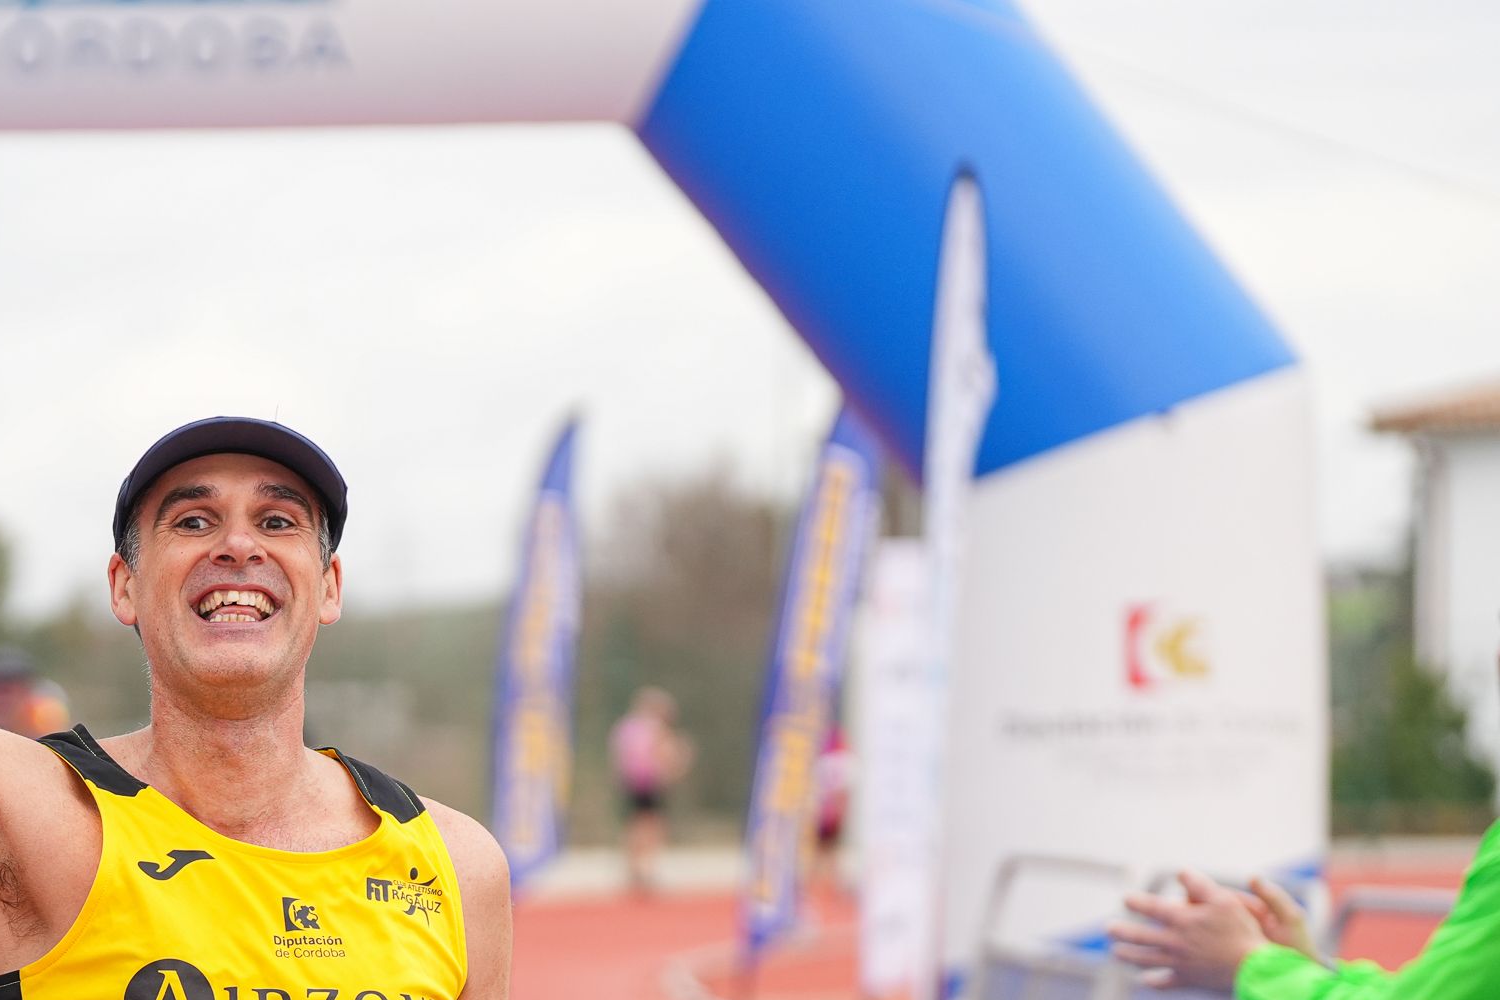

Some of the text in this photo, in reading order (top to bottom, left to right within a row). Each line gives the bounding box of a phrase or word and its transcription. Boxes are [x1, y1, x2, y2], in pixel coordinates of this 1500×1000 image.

[408, 884, 443, 897] ATLETISMO
[273, 935, 343, 948] Diputación
[275, 948, 290, 958] de
